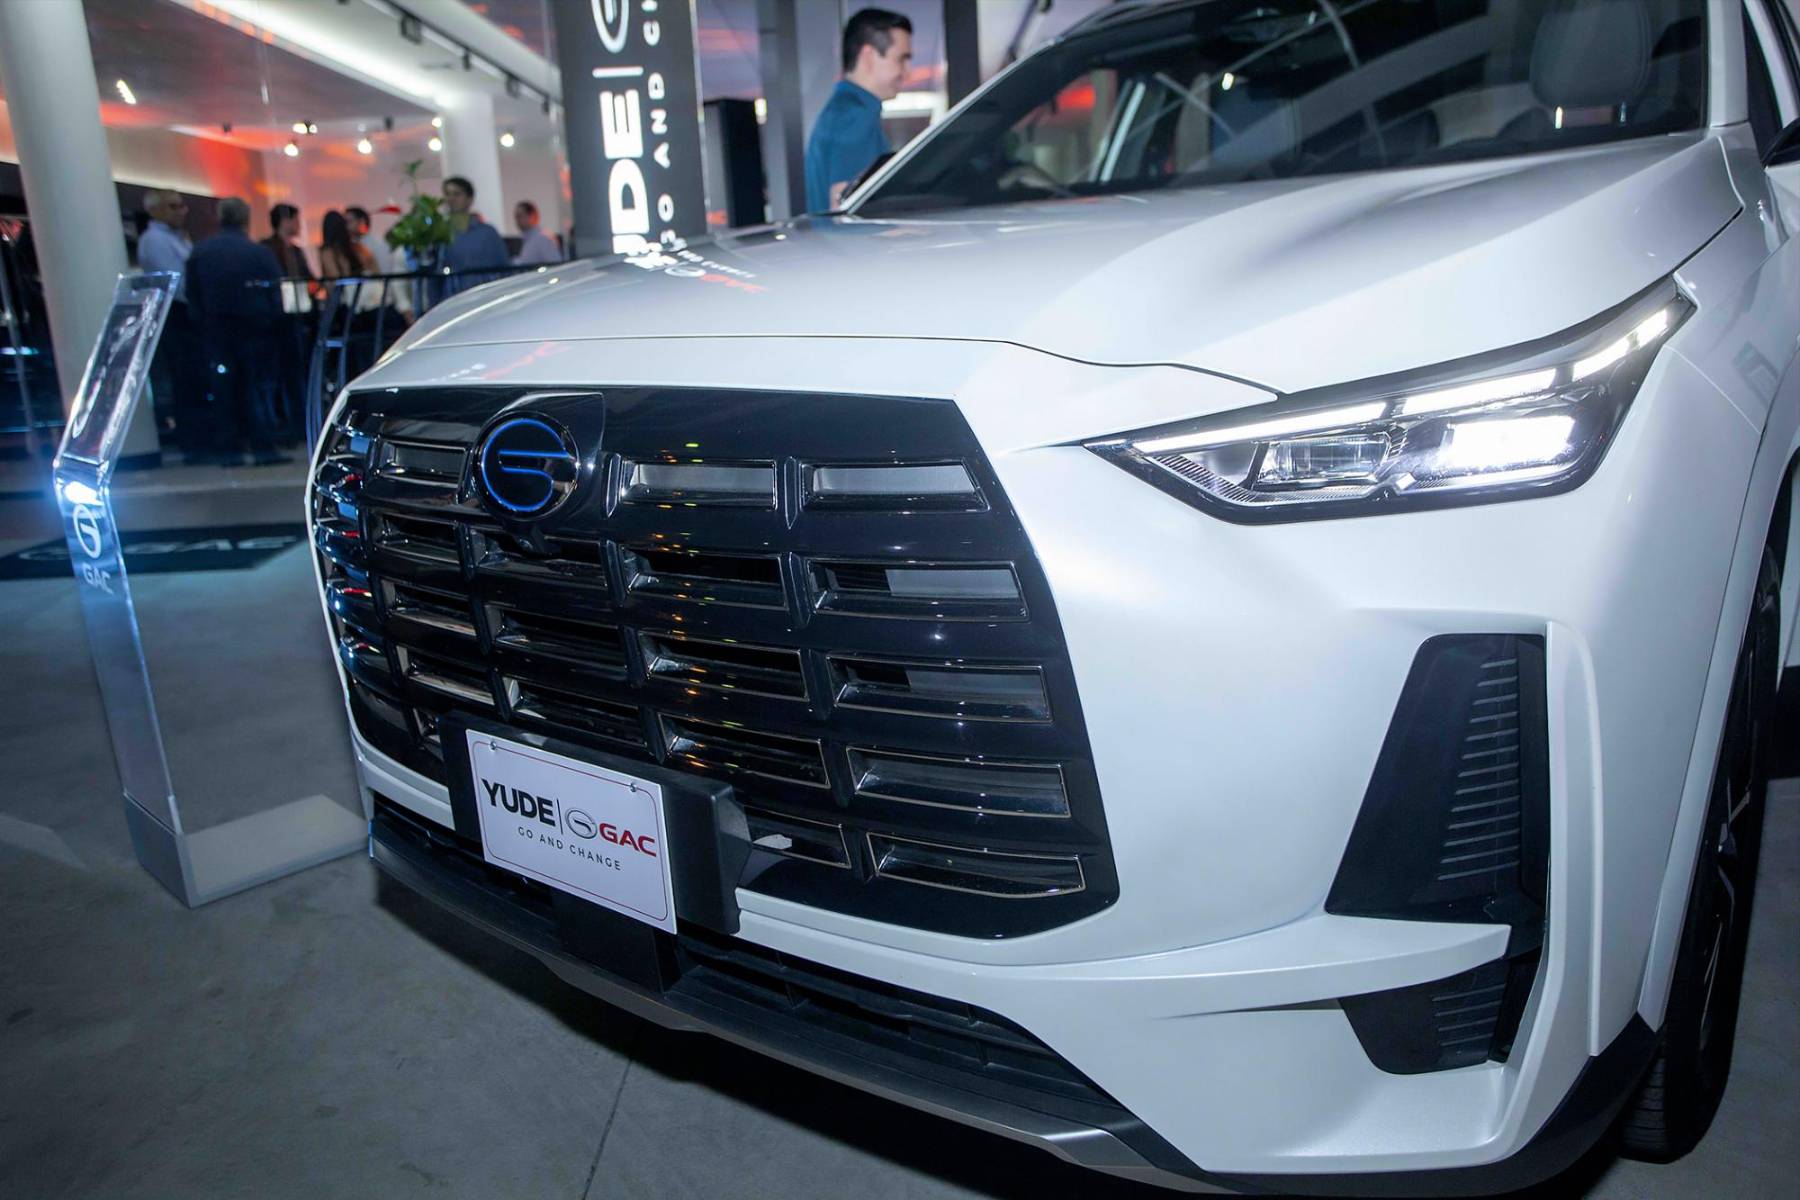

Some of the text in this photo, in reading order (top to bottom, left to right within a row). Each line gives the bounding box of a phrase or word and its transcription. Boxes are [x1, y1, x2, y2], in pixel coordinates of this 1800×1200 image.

[648, 72, 671, 169] AND
[82, 562, 114, 595] GAC
[481, 779, 657, 857] YUDE GAC
[518, 826, 621, 871] GO AND CHANGE
